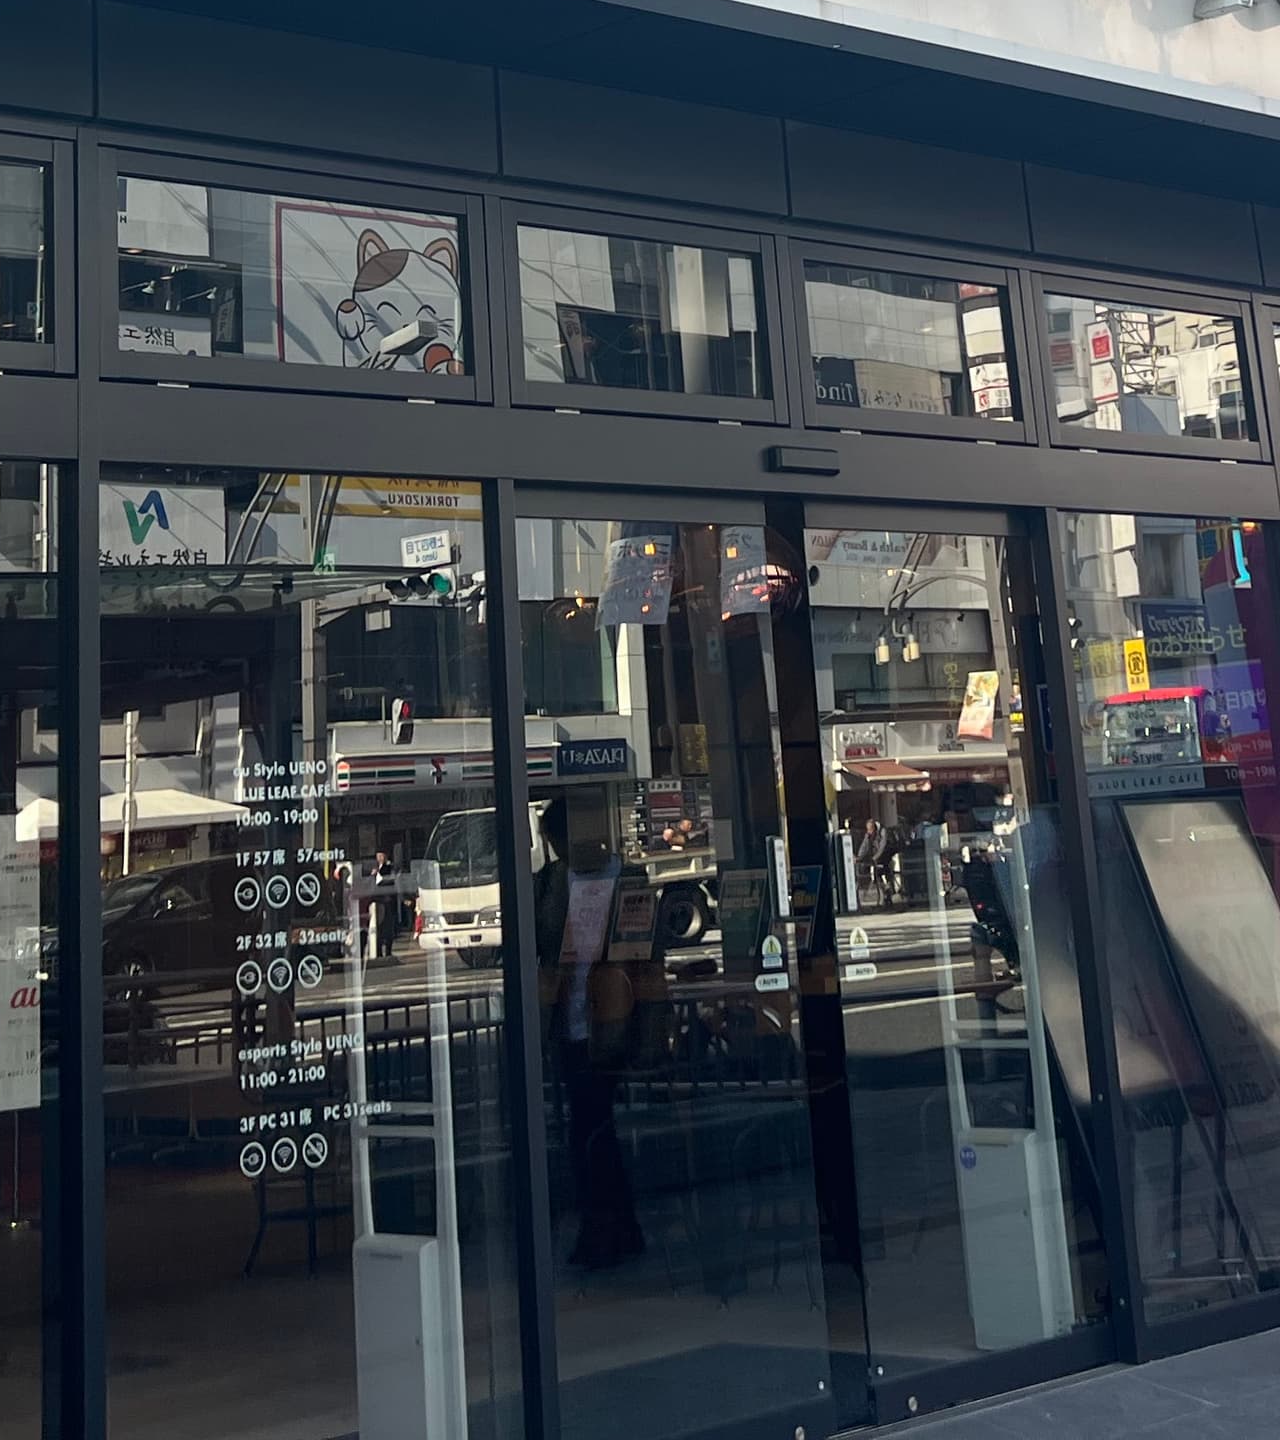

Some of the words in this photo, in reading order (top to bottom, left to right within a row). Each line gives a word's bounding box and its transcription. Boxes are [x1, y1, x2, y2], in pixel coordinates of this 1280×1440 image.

[254, 762, 286, 781] Style
[289, 760, 326, 776] UENO
[267, 785, 297, 800] LEAF
[235, 810, 272, 827] 10:00
[283, 807, 319, 825] 19:00
[236, 852, 250, 867] 1F
[254, 850, 270, 867] 57
[236, 935, 252, 952] 2F
[255, 933, 272, 950] 32
[238, 1043, 288, 1063] esports
[290, 1037, 323, 1057] Style
[240, 1070, 277, 1091] 11:00
[288, 1065, 326, 1084] 21:00
[239, 1116, 256, 1134] 3F
[259, 1113, 277, 1131] PC
[279, 1110, 296, 1128] 31
[323, 1104, 340, 1121] PC
